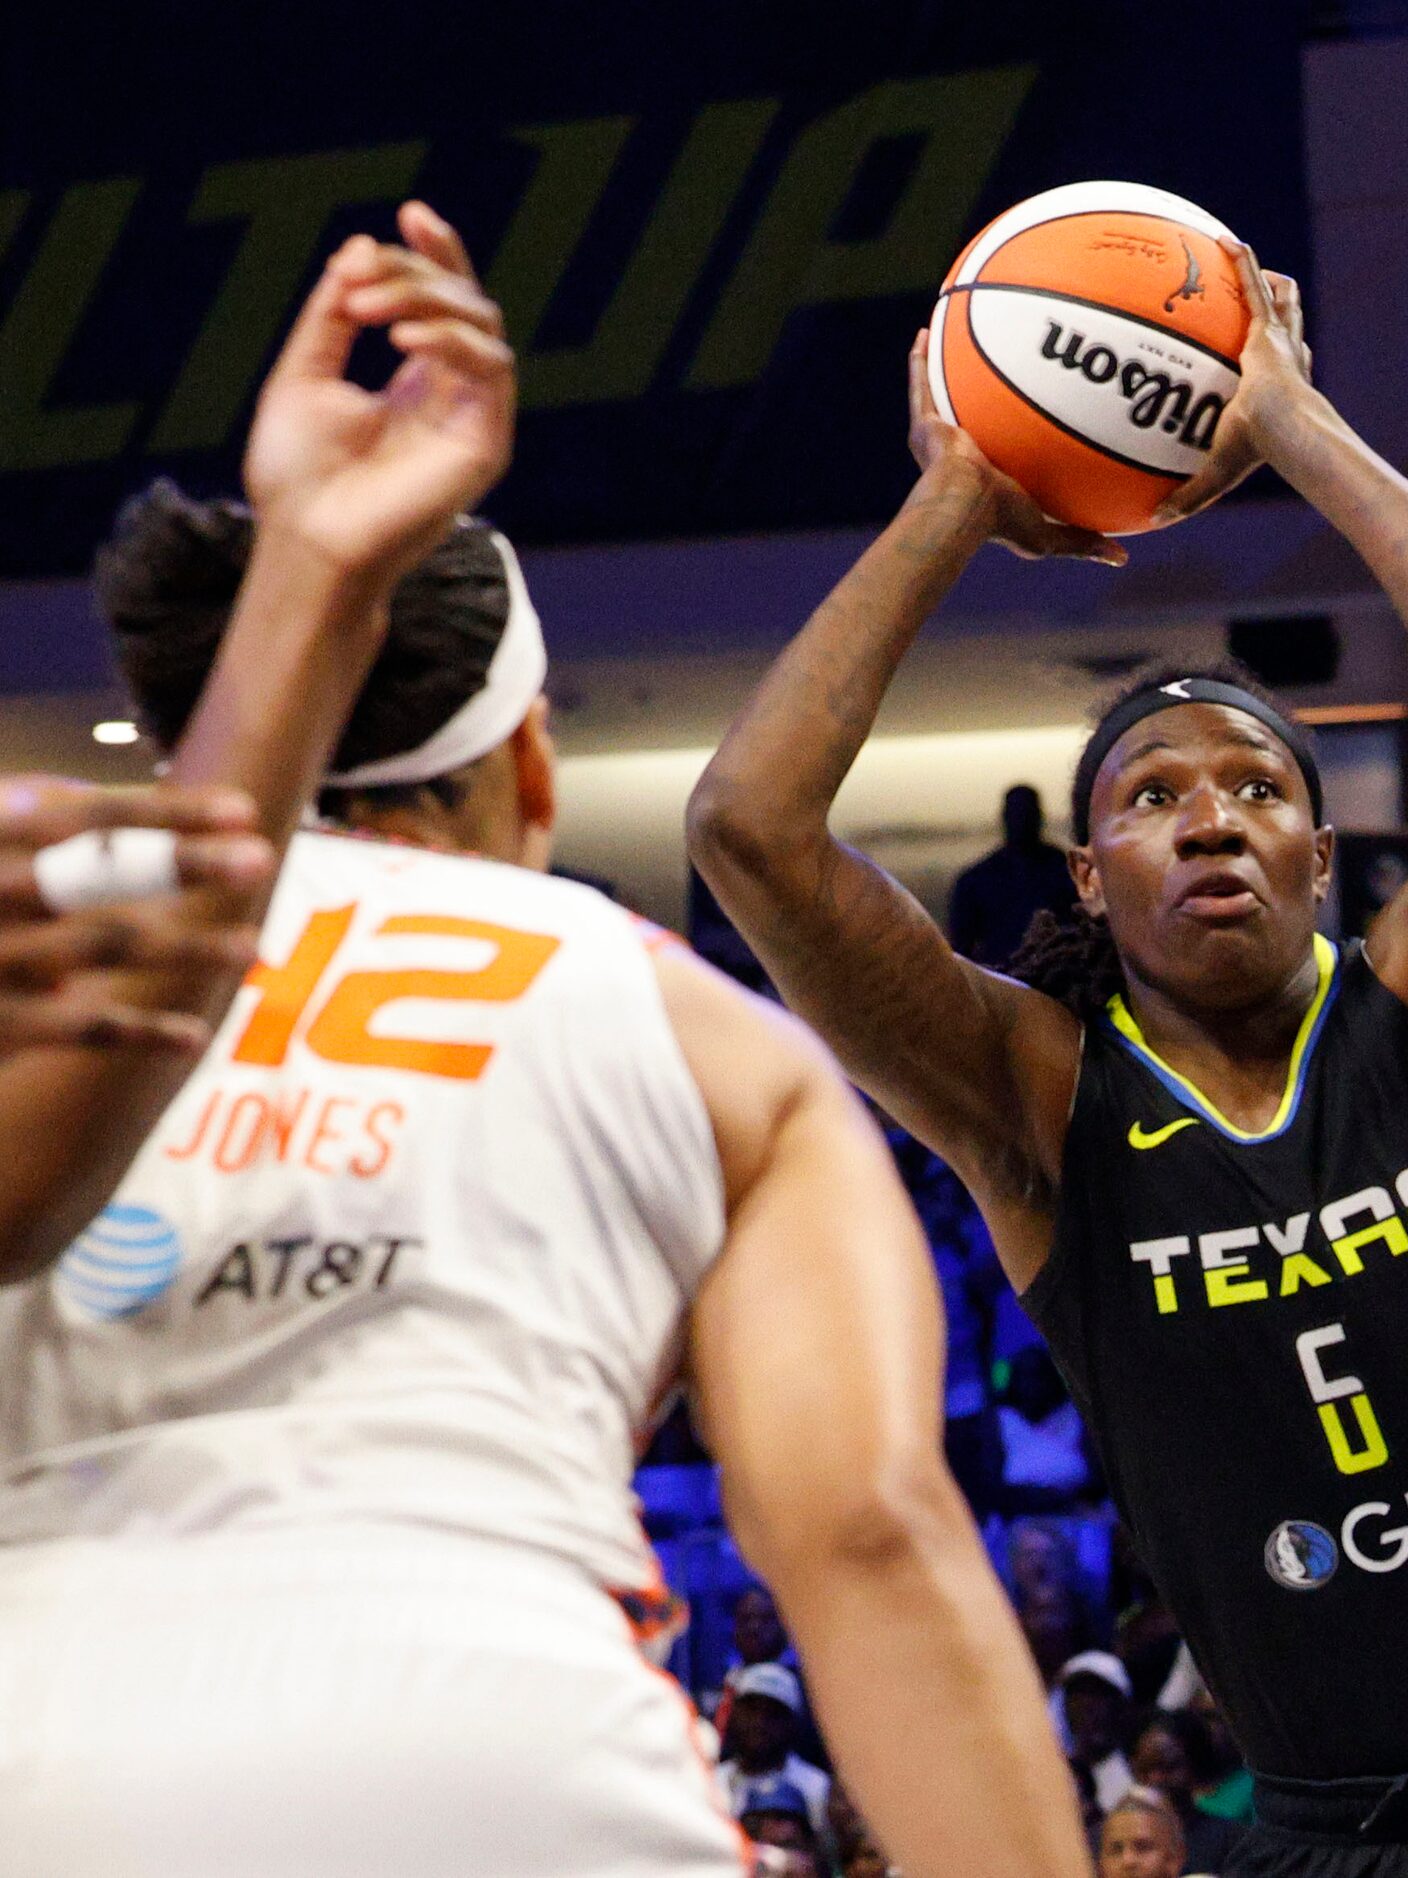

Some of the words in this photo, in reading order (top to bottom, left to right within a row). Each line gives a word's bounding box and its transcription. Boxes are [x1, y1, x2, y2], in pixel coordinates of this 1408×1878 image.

[0, 134, 432, 471] LT
[483, 61, 1042, 413] UP
[163, 1085, 405, 1181] JONES
[194, 1236, 425, 1309] AT&T
[1296, 1322, 1389, 1475] 6
